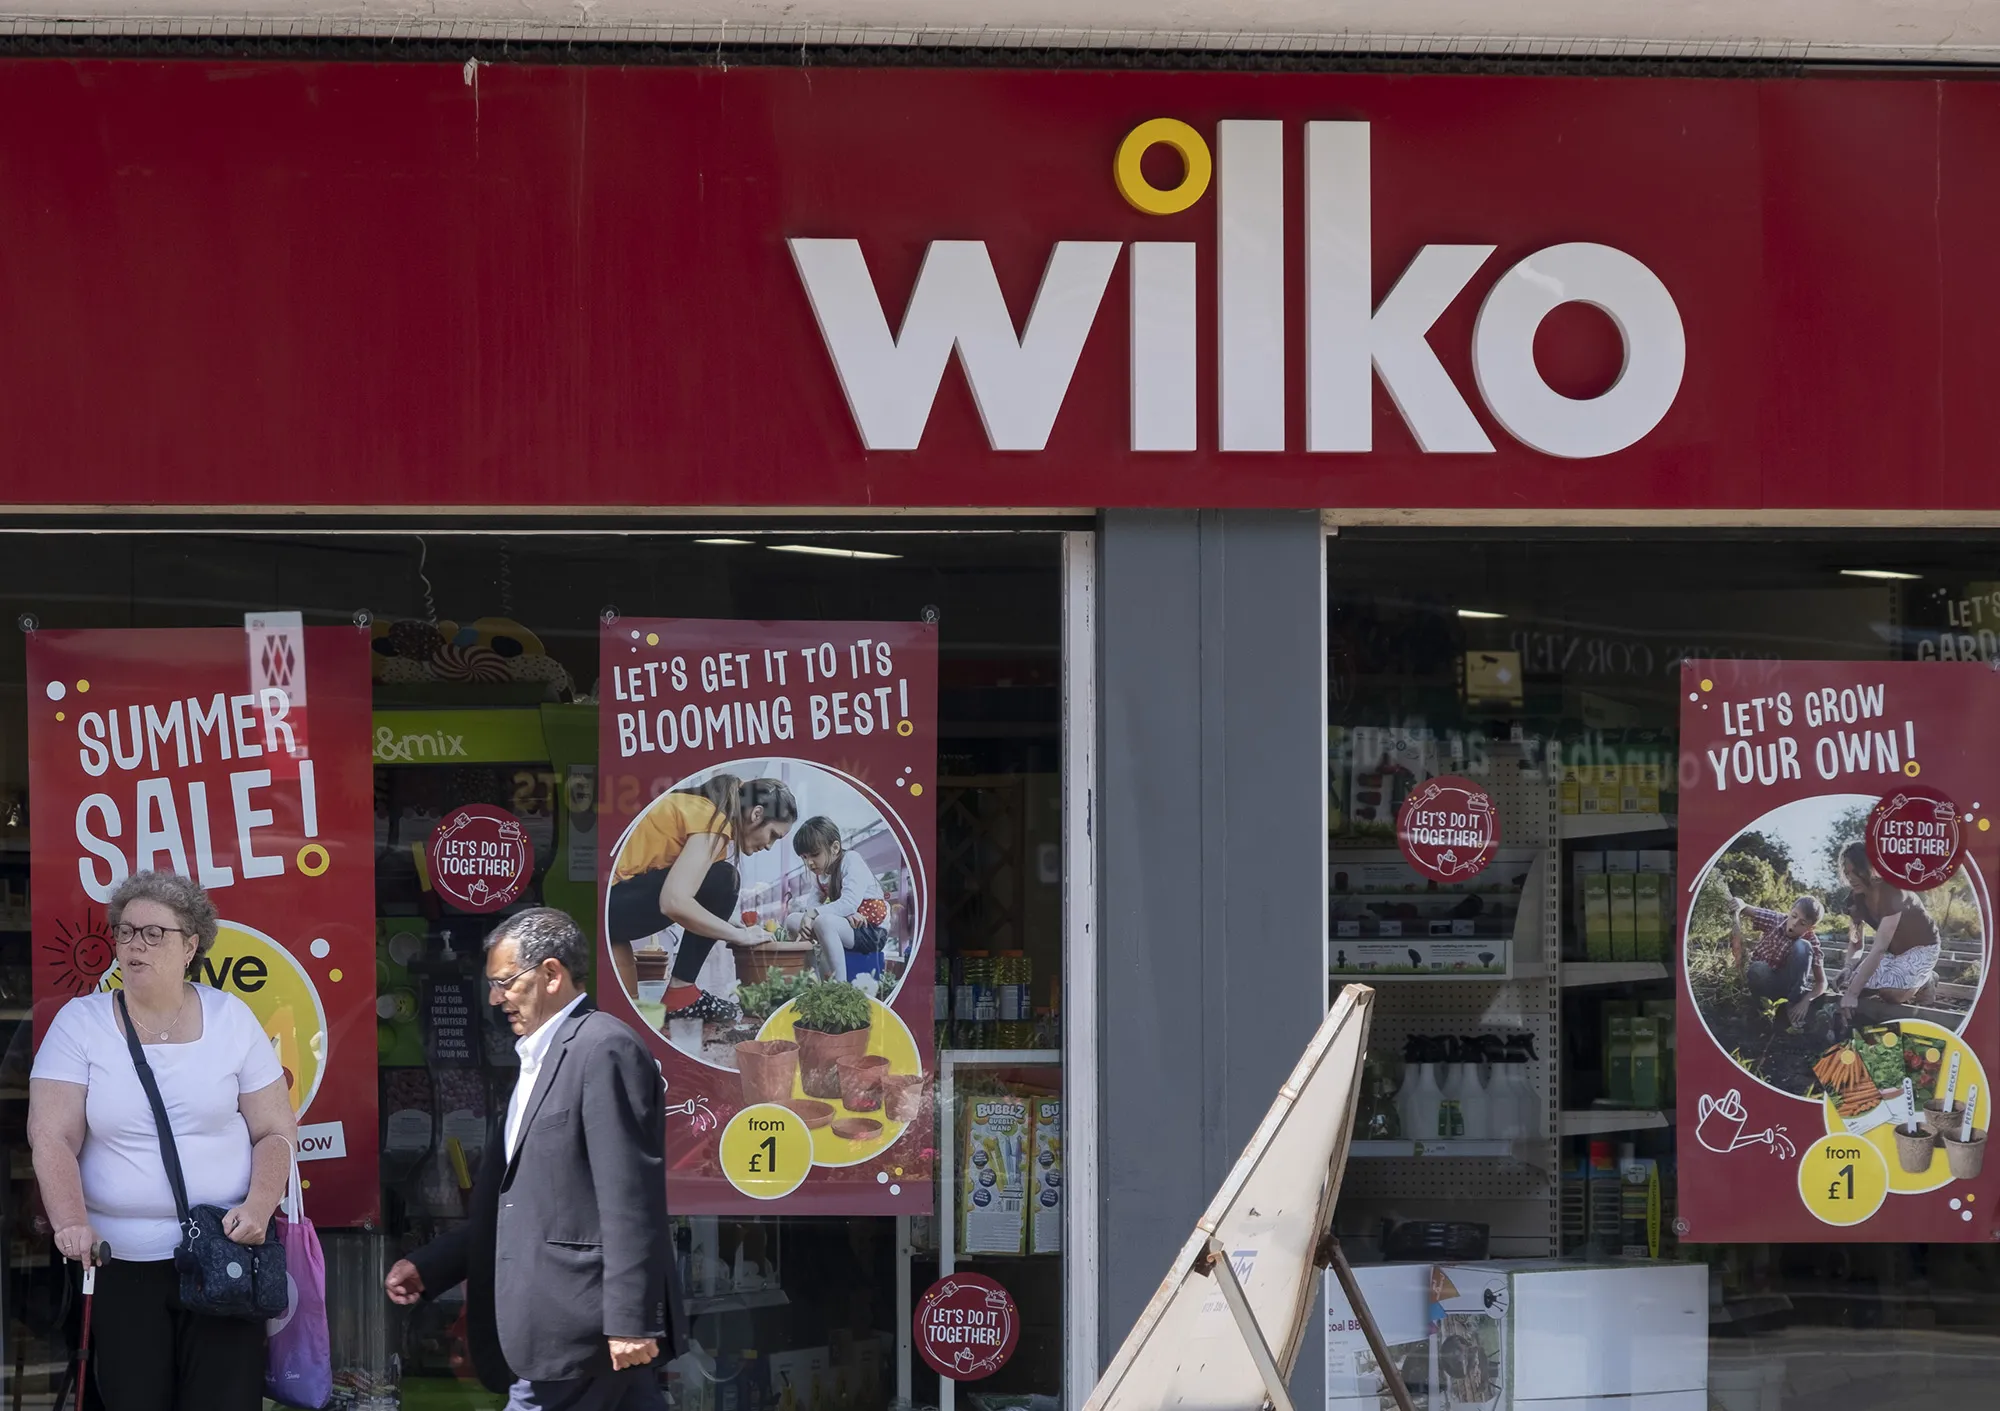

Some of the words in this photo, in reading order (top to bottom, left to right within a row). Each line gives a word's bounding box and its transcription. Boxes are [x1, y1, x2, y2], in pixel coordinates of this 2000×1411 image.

[787, 117, 1686, 458] wilko
[1947, 591, 2000, 627] LET'S
[1918, 628, 1999, 661] GARD
[613, 656, 688, 702] LET'S
[701, 652, 750, 693] GET
[764, 649, 788, 686] IT
[801, 642, 837, 683] TO
[850, 638, 893, 679] ITS
[617, 696, 794, 758] BLOOMING
[810, 678, 914, 741] BEST!
[1723, 692, 1793, 736] LET'S
[1805, 683, 1885, 728] GROW
[77, 687, 297, 777] SUMMER
[373, 726, 467, 761] &mix
[1708, 736, 1801, 791] YOUR
[1816, 720, 1921, 780] OWN!
[1416, 811, 1447, 827] LET'S
[1450, 812, 1468, 828] DO
[1469, 814, 1481, 828] IT
[1884, 820, 1914, 835] LET'S
[1917, 821, 1934, 836] DO
[1936, 822, 1947, 837] IT
[75, 760, 330, 904] SALE!
[1411, 827, 1483, 849] TOGETHER!
[446, 840, 477, 856] LET'S
[481, 842, 498, 857] DO
[500, 843, 512, 858] IT
[1880, 836, 1950, 857] TOGETHER!
[442, 857, 515, 878] TOGETHER!
[203, 956, 268, 993] ve
[435, 985, 460, 993] PLEASE
[434, 996, 446, 1004] USE
[448, 996, 463, 1004] OUR
[431, 1007, 447, 1015] FREE
[433, 1017, 468, 1026] SANITISER
[438, 1028, 464, 1037] BEFORE
[437, 1050, 455, 1058] YOUR
[456, 1050, 469, 1058] MIX
[438, 1039, 466, 1048] PICKING
[976, 1103, 1026, 1118] BUBBLZ
[1905, 1086, 1914, 1116] CARROT
[748, 1118, 785, 1131] from
[748, 1136, 776, 1173] £1
[1826, 1146, 1860, 1159] from
[1828, 1164, 1854, 1200] £1
[933, 1308, 964, 1324] LET'S
[967, 1309, 984, 1326] DO
[987, 1311, 998, 1326] IT
[928, 1325, 1001, 1346] TOGETHER!
